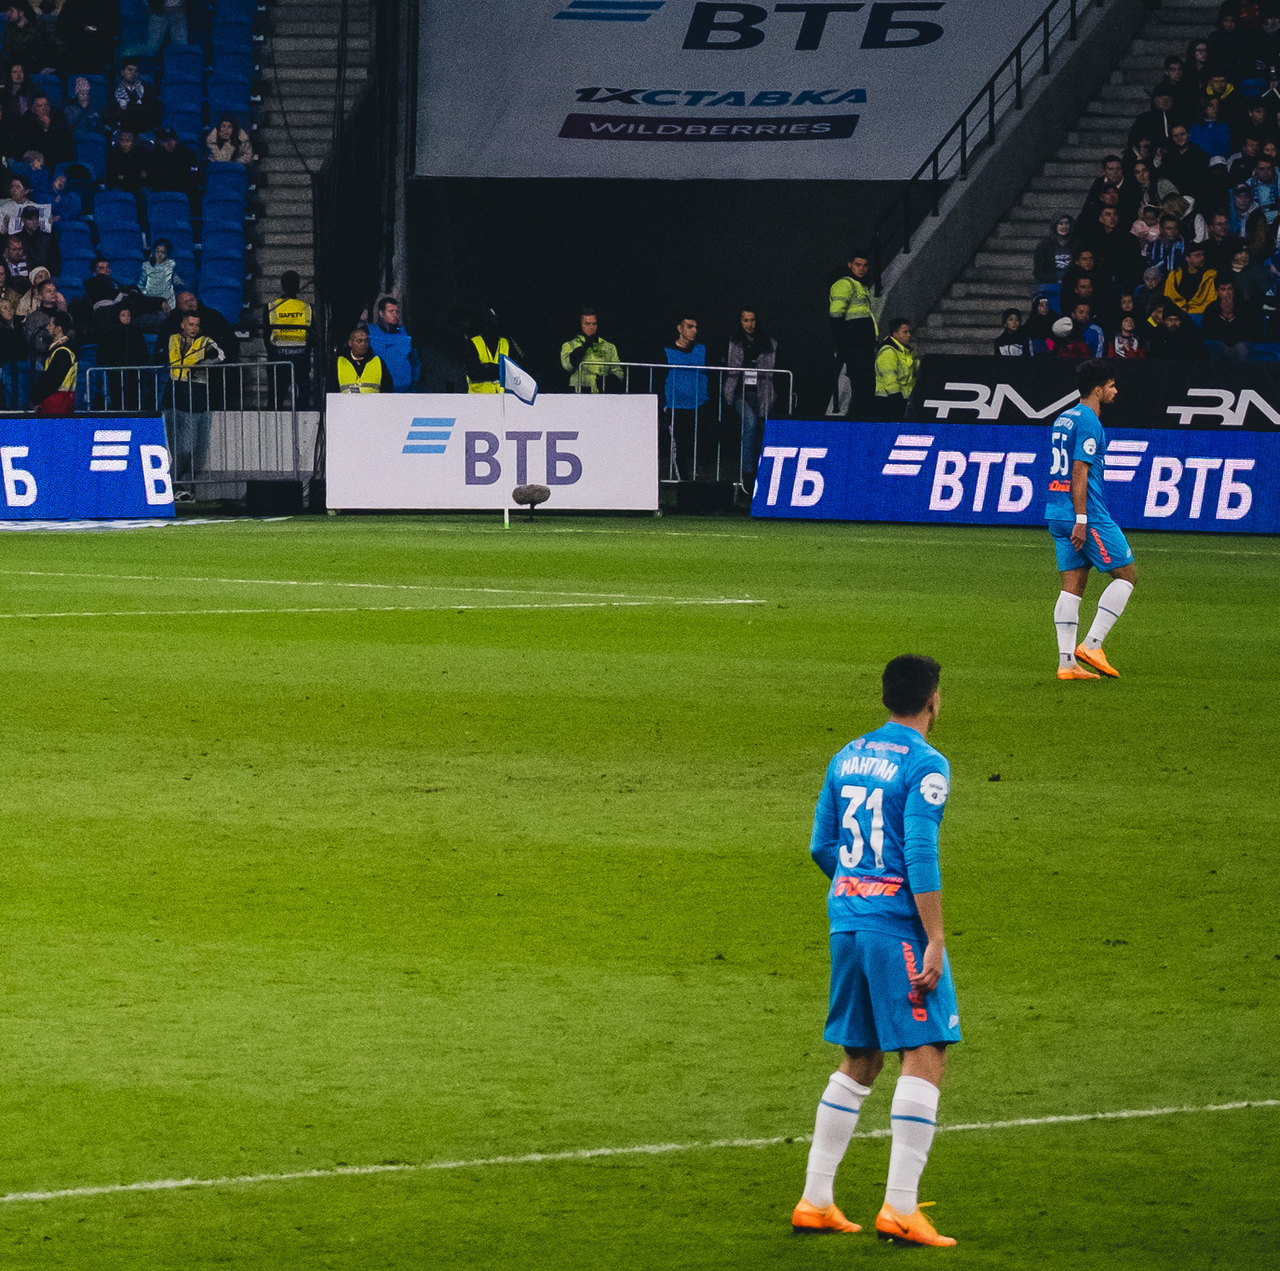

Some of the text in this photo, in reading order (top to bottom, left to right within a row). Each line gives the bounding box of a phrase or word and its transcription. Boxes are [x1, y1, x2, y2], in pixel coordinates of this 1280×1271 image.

[681, 1, 946, 51] ВТБ
[588, 121, 832, 139] WILDBERRIES
[464, 431, 583, 486] ВТБ
[929, 451, 1036, 514] ВТБ
[1144, 457, 1255, 520] ВТБ
[839, 785, 884, 869] 31
